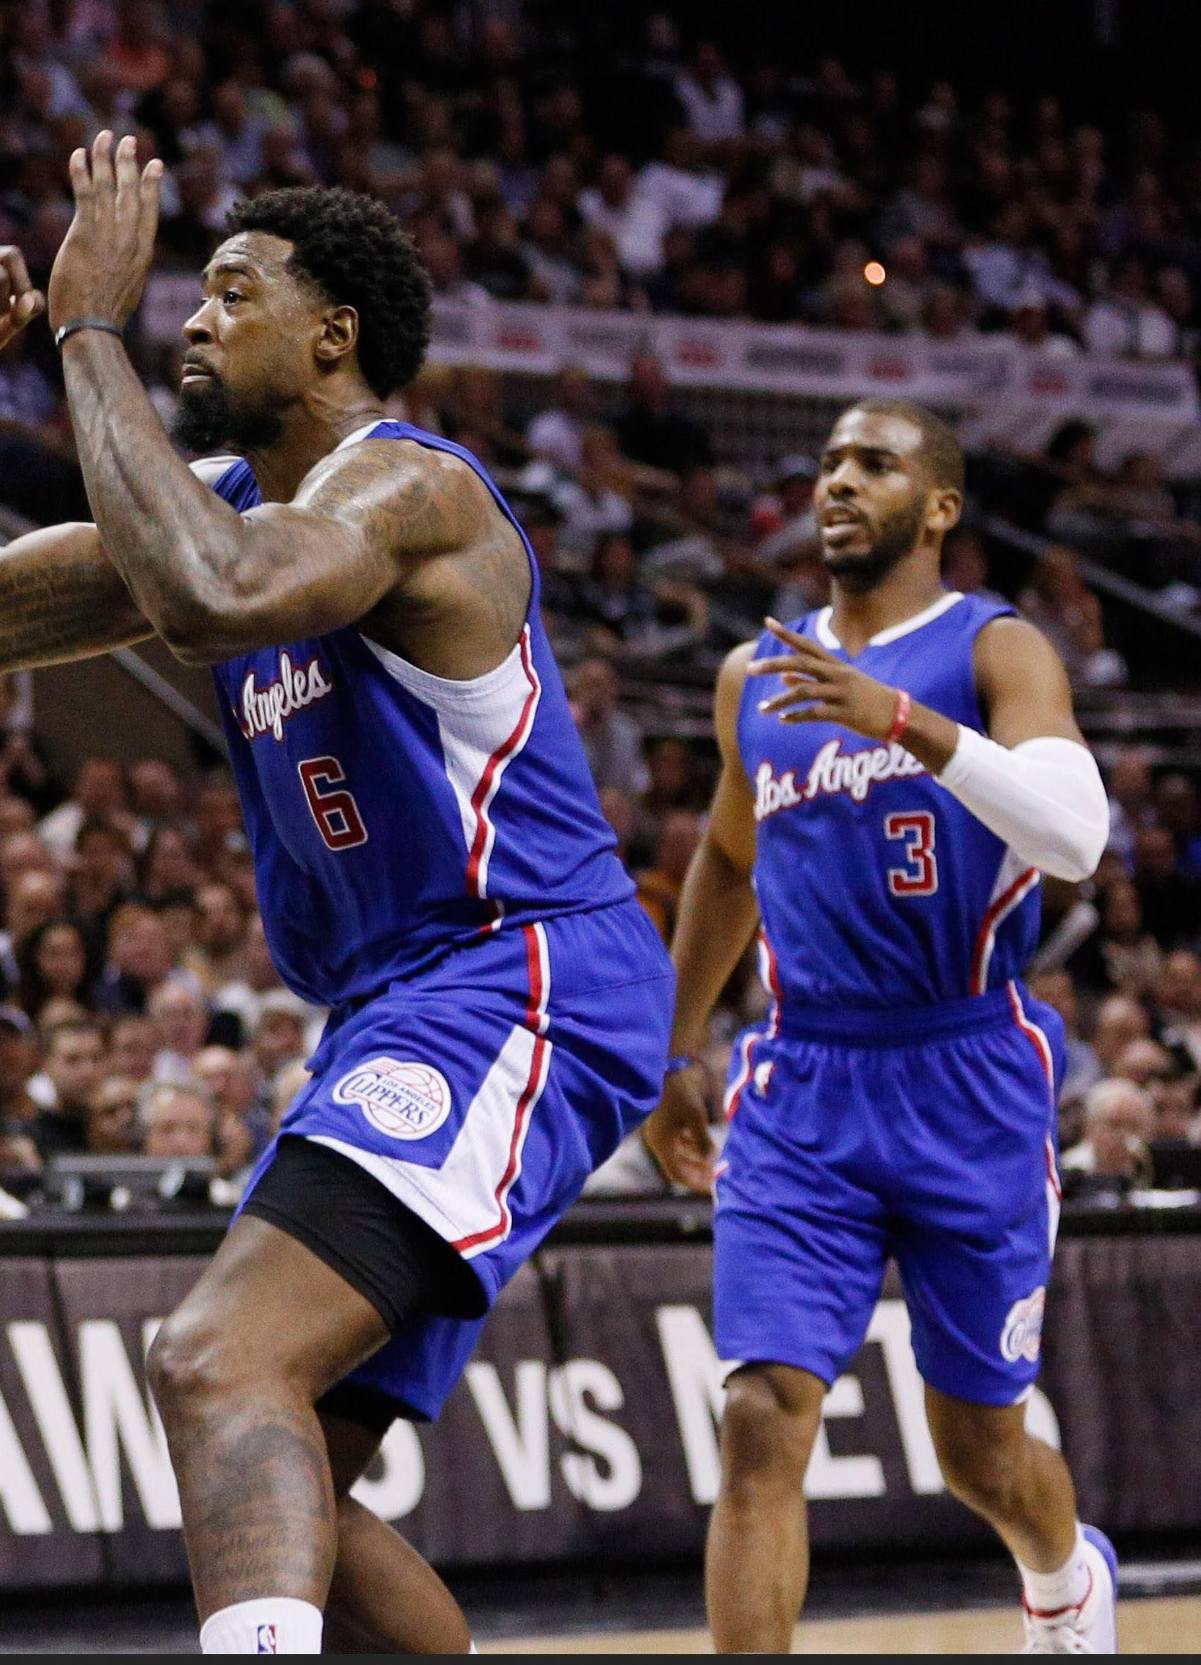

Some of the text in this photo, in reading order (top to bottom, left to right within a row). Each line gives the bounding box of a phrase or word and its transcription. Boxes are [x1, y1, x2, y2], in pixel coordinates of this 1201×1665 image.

[297, 756, 369, 852] 6
[884, 810, 940, 898] 3
[338, 1071, 432, 1126] CLIPPERS
[464, 1358, 643, 1512] VS
[655, 1301, 1062, 1504] NET
